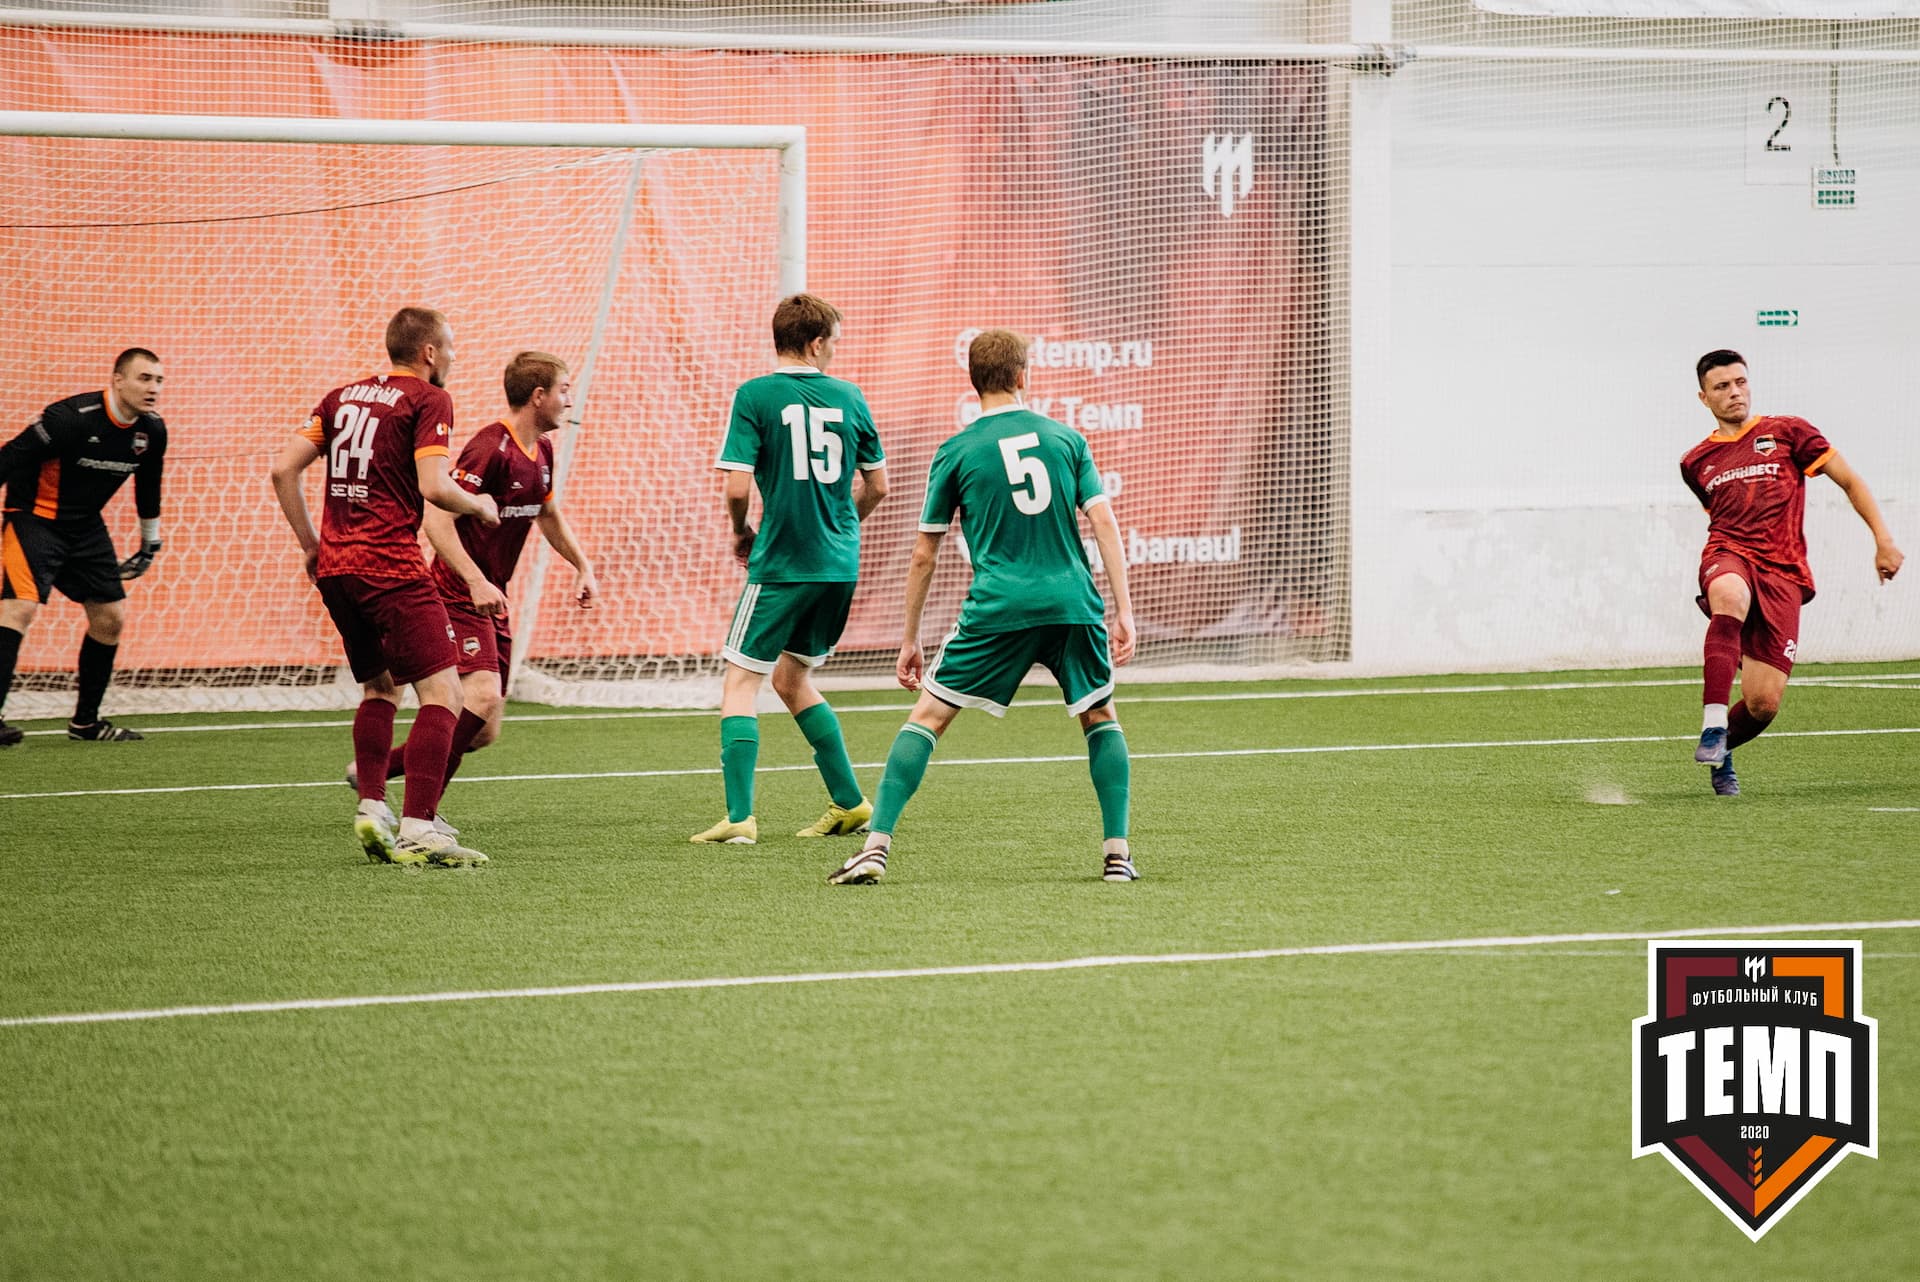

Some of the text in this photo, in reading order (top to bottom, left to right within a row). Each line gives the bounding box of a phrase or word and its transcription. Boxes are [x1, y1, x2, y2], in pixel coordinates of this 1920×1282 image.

[1765, 97, 1790, 151] 2
[1029, 336, 1152, 376] temp.ru
[331, 404, 380, 480] 24
[781, 404, 844, 484] 15
[998, 432, 1052, 515] 5
